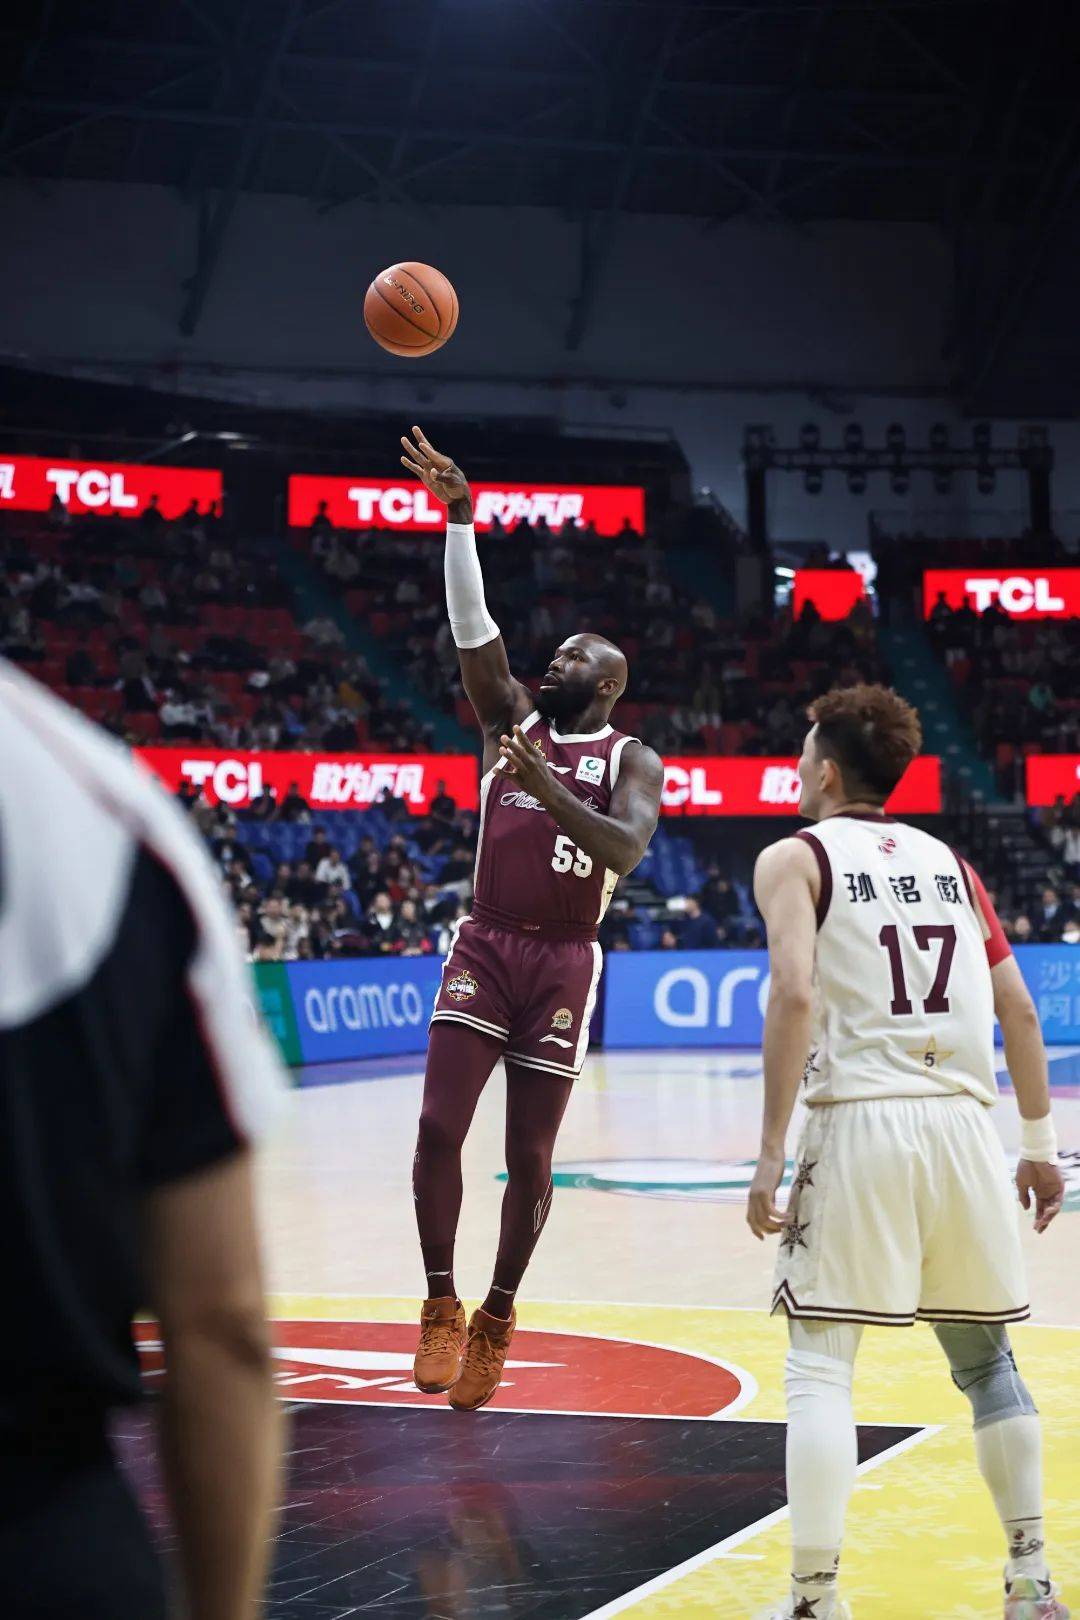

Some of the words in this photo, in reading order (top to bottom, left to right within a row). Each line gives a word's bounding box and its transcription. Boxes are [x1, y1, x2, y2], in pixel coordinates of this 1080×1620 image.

[46, 468, 138, 508] TCL
[348, 487, 442, 524] TCL
[964, 576, 1065, 613] TCL
[180, 759, 277, 803] TCL
[661, 765, 723, 806] CL
[843, 872, 962, 904] 孙铭徽
[879, 924, 957, 1016] 17
[304, 981, 423, 1033] aramco
[924, 1051, 936, 1068] 5
